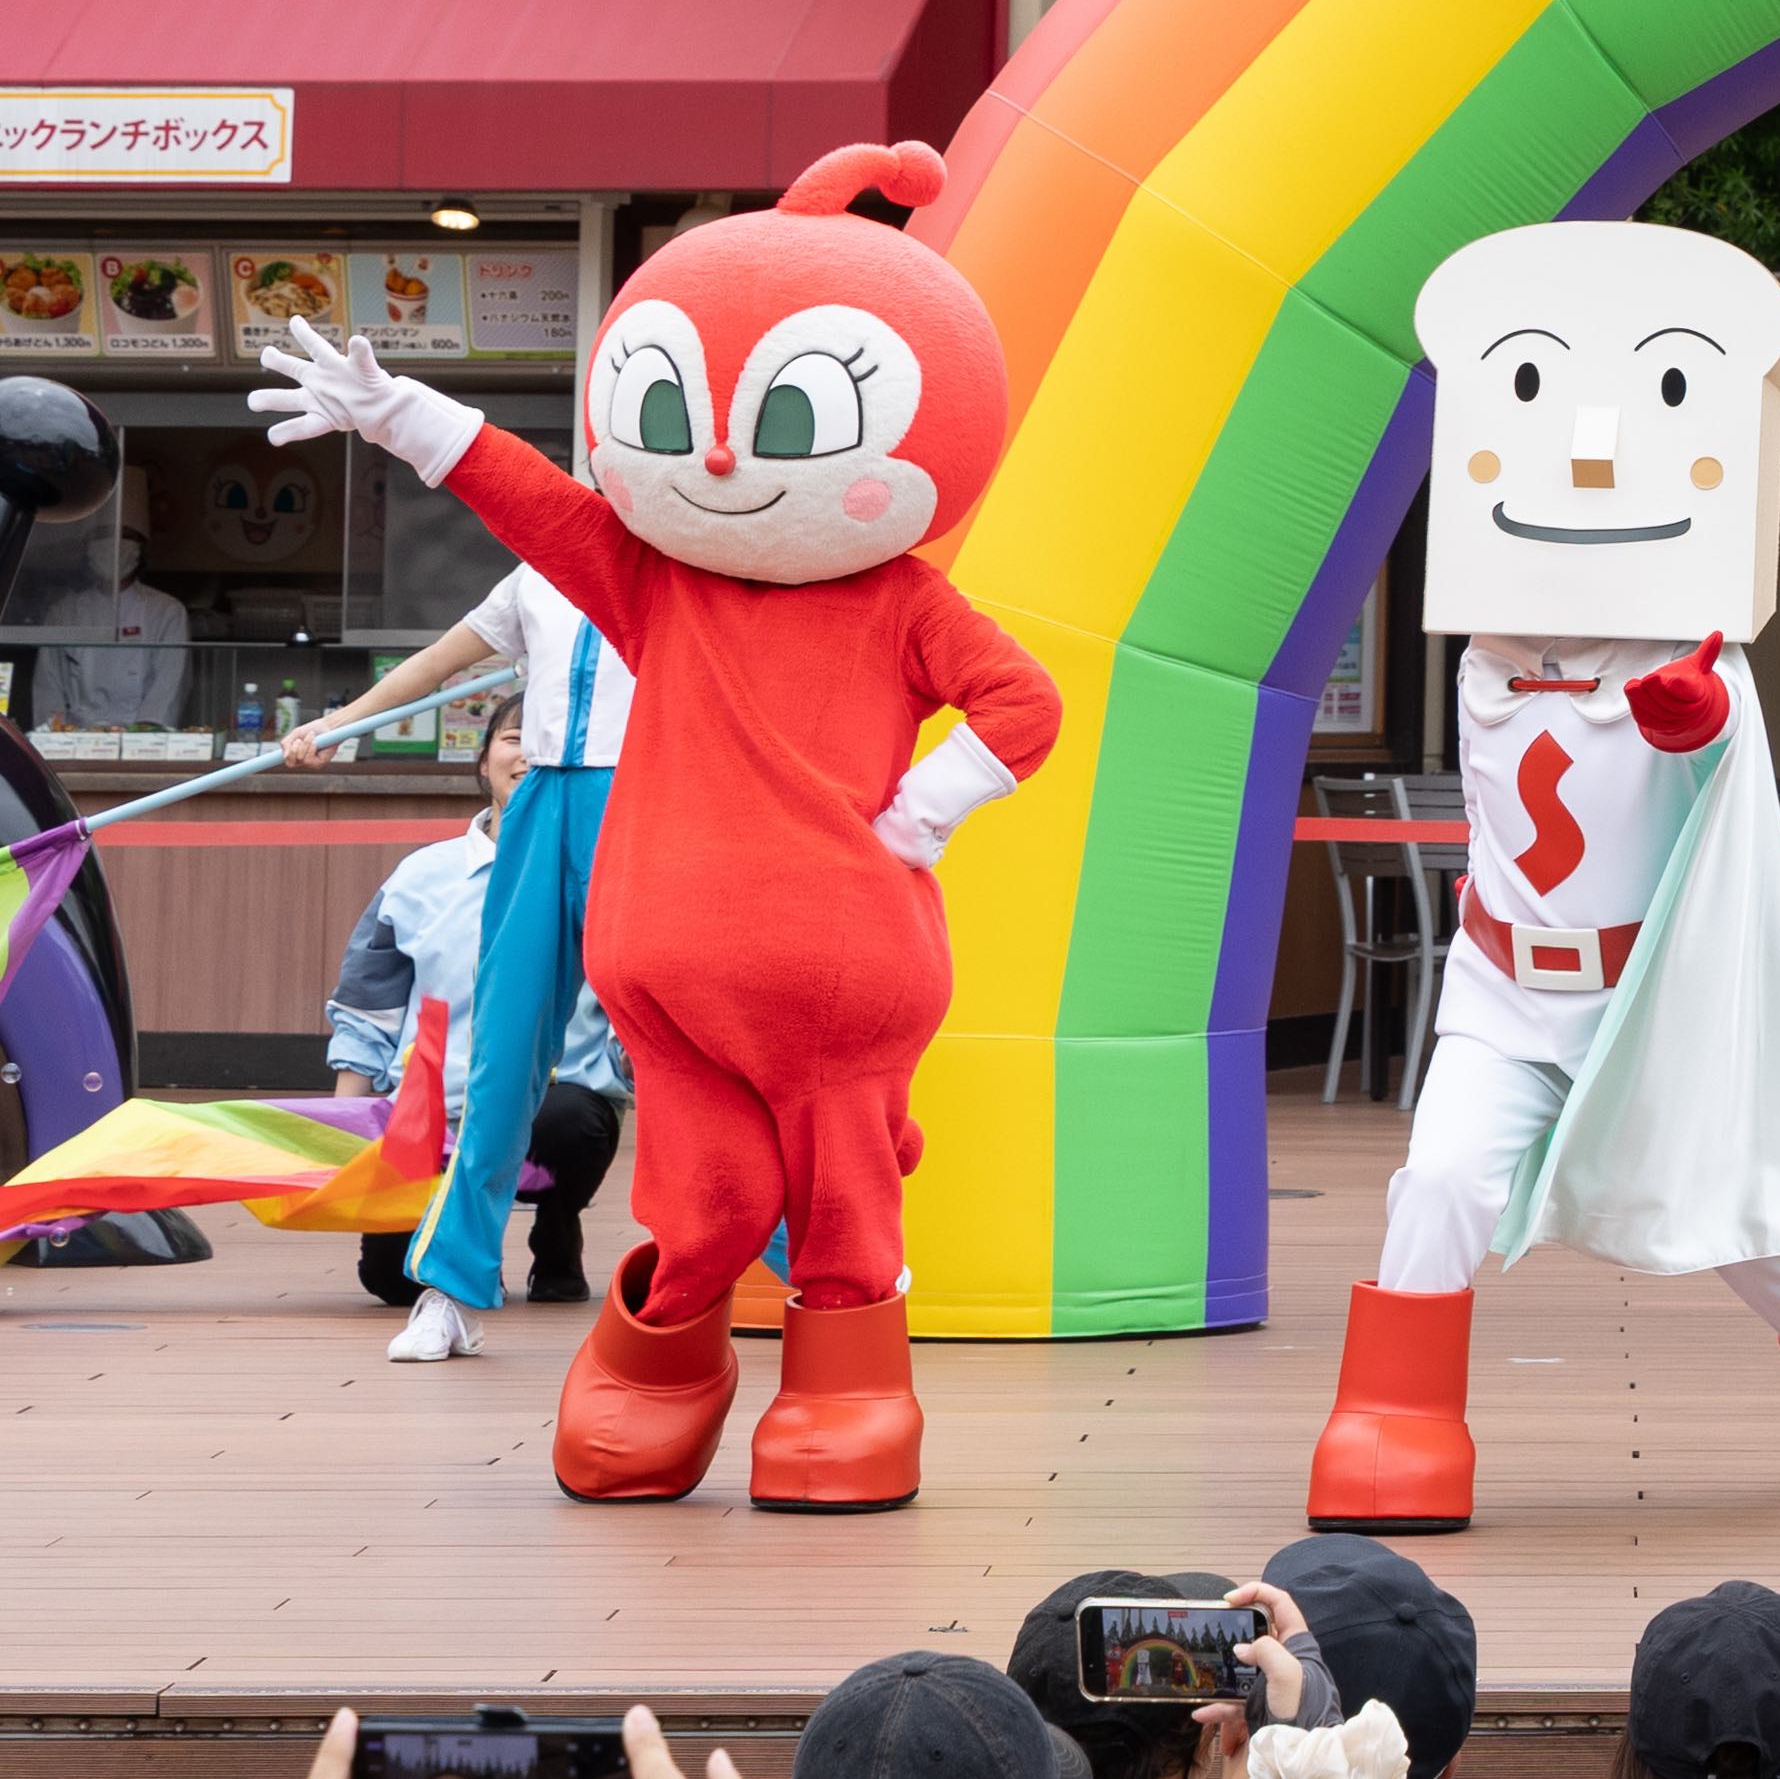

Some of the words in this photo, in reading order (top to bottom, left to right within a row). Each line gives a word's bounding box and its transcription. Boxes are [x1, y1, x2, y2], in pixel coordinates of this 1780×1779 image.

[0, 117, 269, 152] ックランチボックス
[360, 327, 420, 337] アンパンマン
